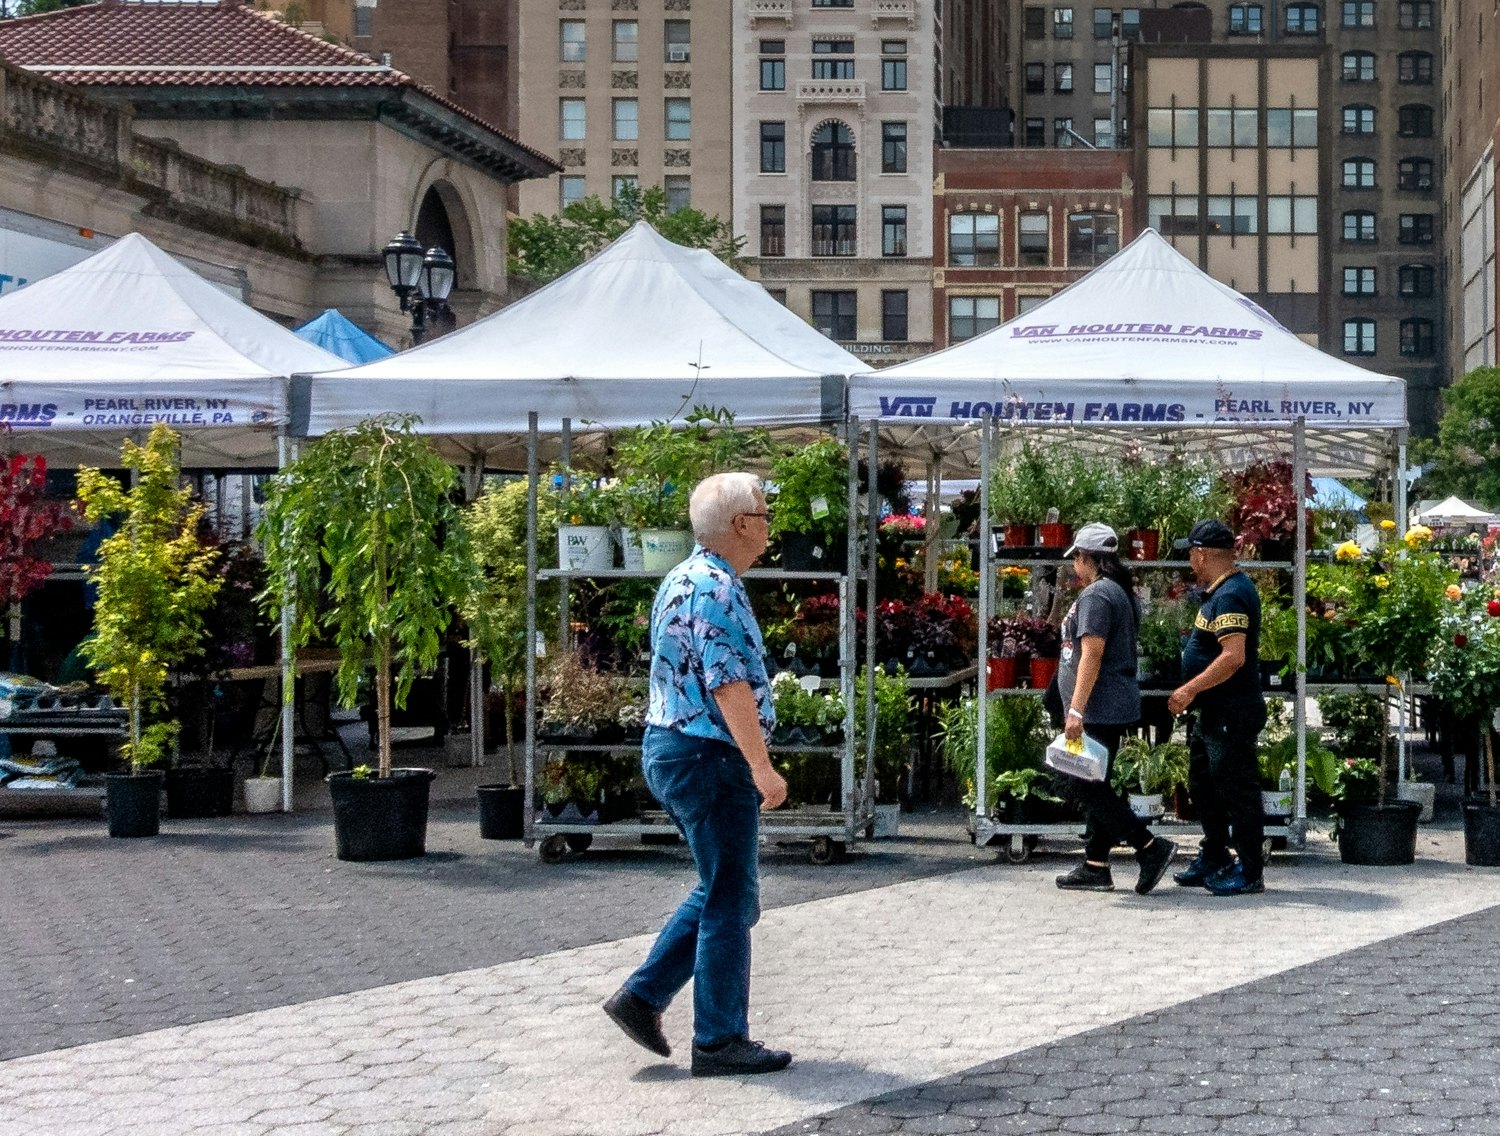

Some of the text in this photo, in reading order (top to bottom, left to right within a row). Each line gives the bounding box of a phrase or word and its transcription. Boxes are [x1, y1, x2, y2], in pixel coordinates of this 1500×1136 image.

[0, 330, 196, 343] HOUTEN FARMS
[1013, 324, 1264, 340] VAN HOUTEN FARMS
[842, 344, 891, 353] UILDING
[84, 398, 229, 411] PEARL RIVER, NY
[879, 396, 937, 417] VAN
[950, 402, 1074, 420] HOUTEN
[1083, 403, 1186, 421] FARMS
[1215, 399, 1375, 417] PEARL RIVER, NY
[83, 413, 233, 426] ORANGEVILLE, PA
